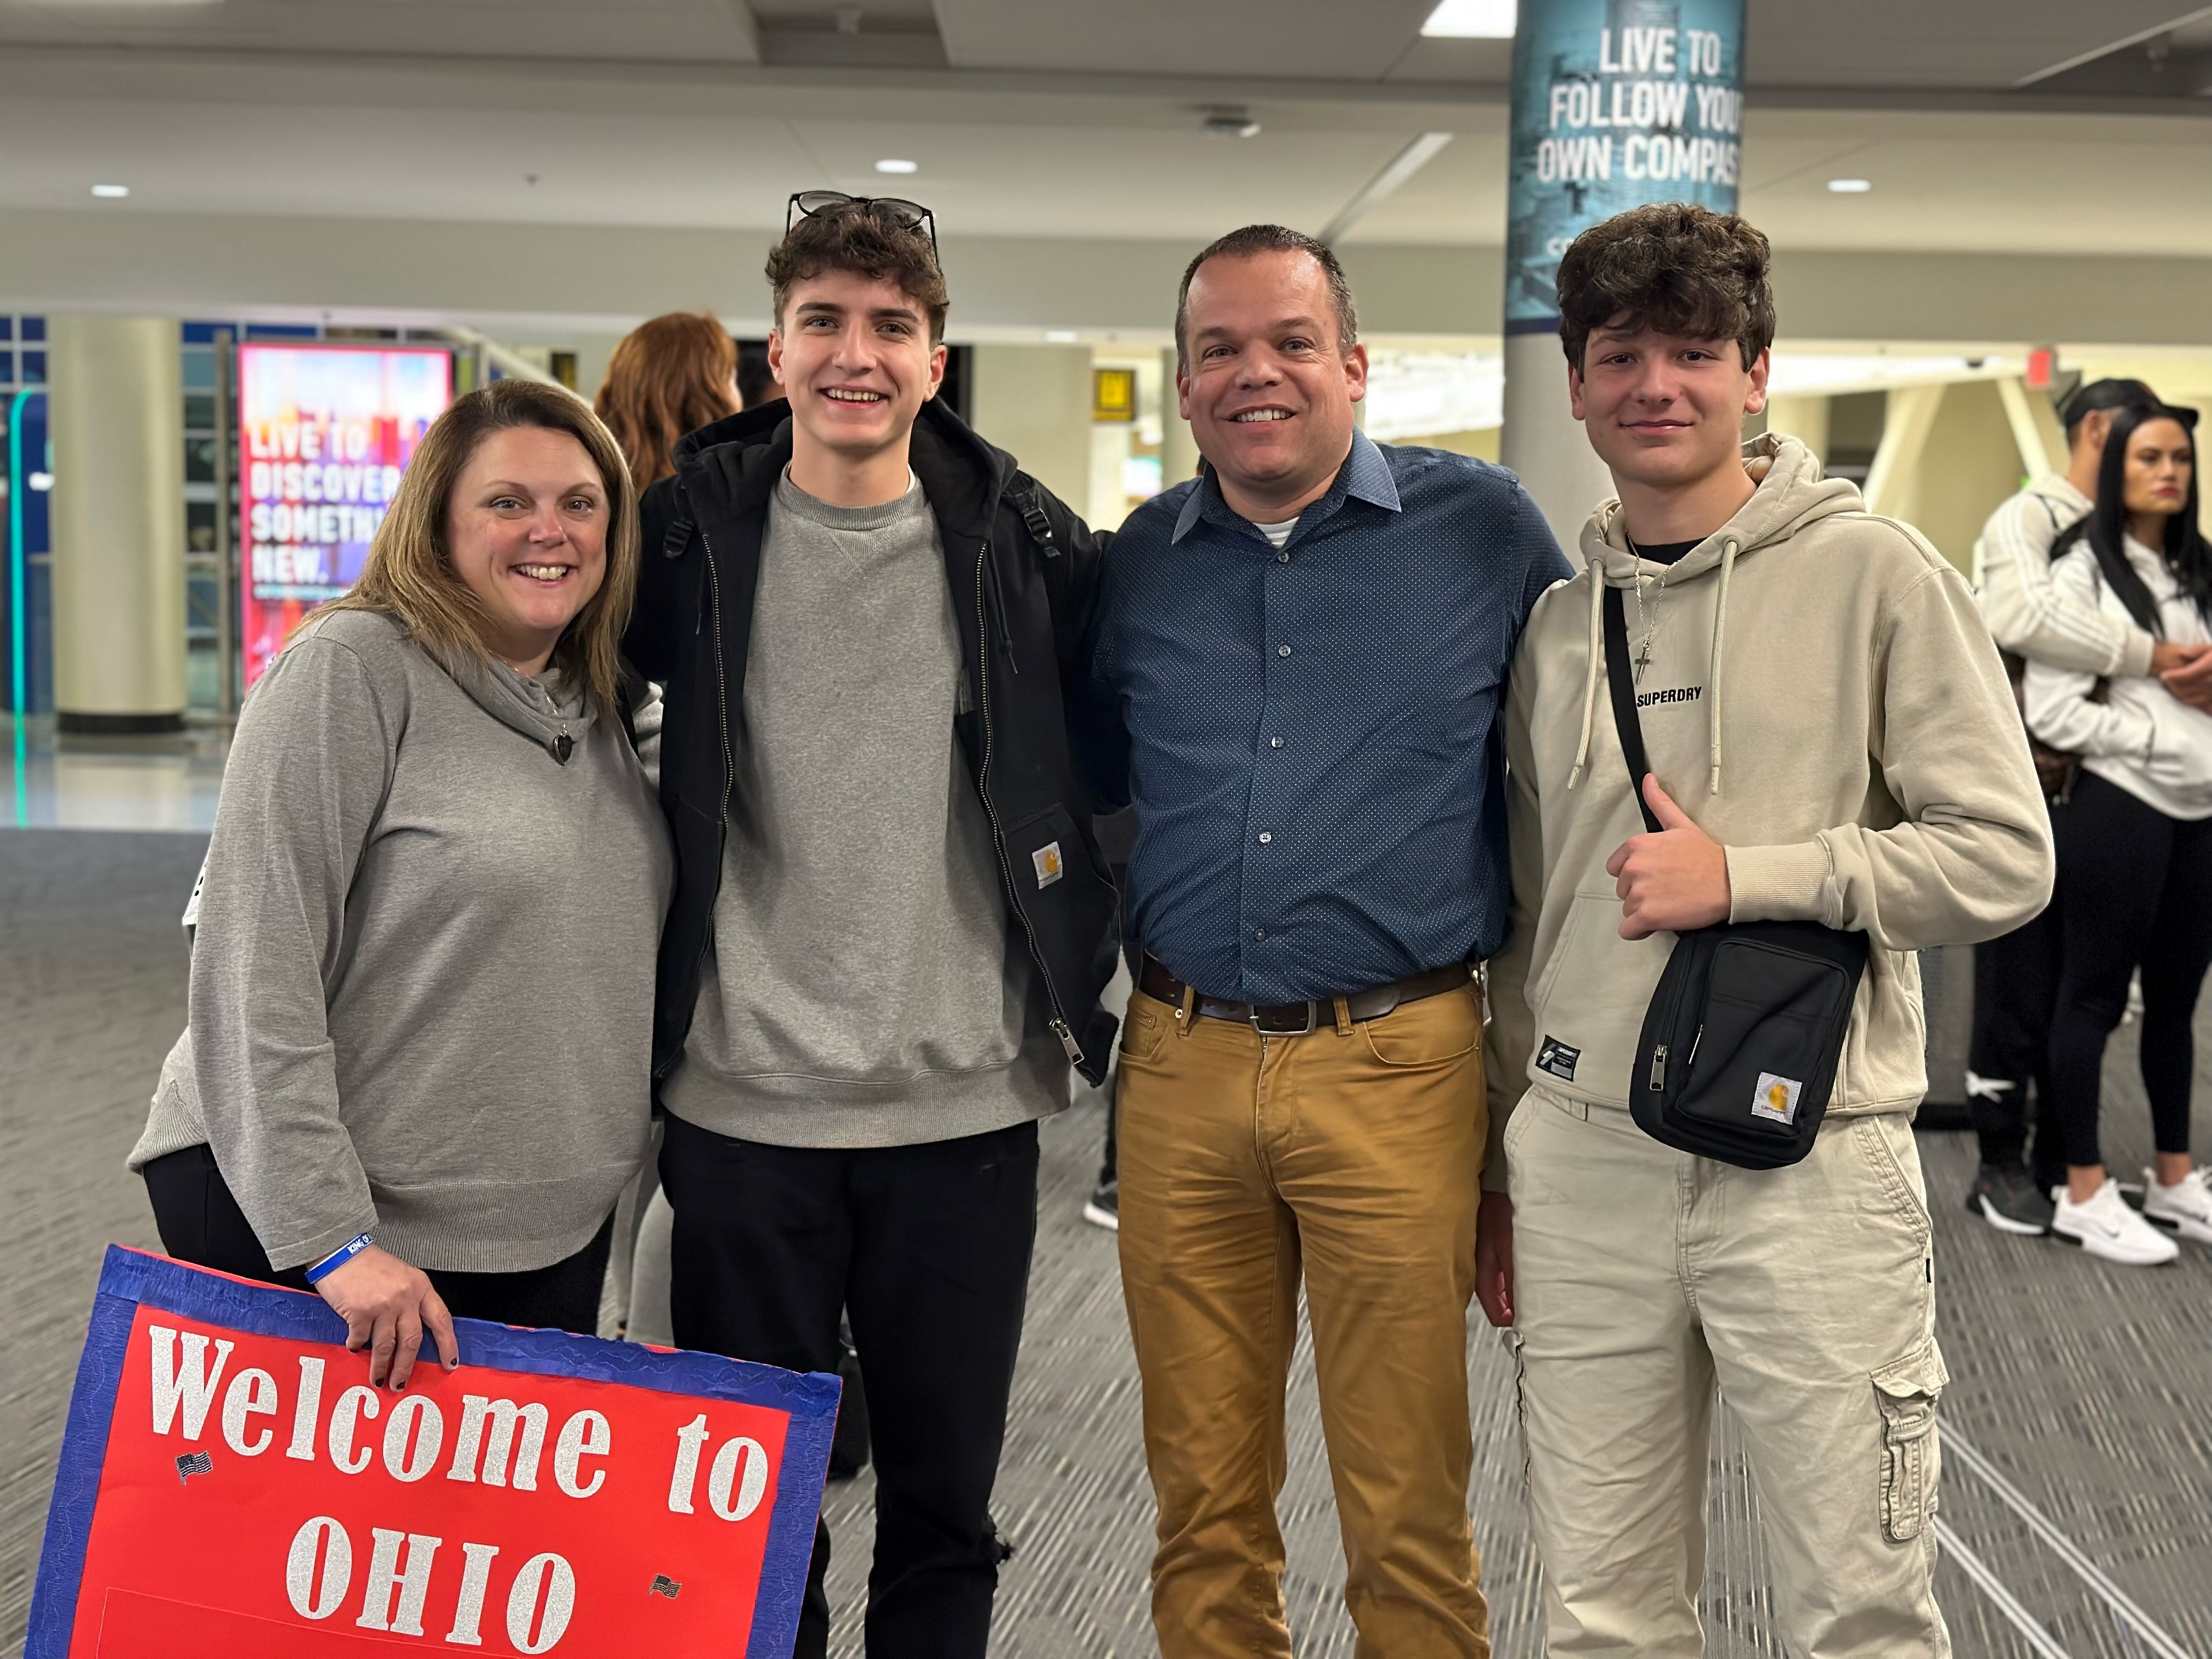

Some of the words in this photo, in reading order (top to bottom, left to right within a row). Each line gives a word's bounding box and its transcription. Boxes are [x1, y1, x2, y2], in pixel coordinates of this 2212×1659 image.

[1599, 28, 1675, 74] LIVE
[1687, 30, 1721, 77] TO
[1549, 83, 1689, 129] FOLLOW
[1538, 136, 1611, 183] OWN
[250, 422, 321, 459] LIVE
[333, 422, 367, 460] TO
[250, 462, 401, 501] DISCOVER
[252, 545, 329, 584] NEW.
[1637, 687, 1702, 707] SUPERDRY
[348, 1239, 364, 1254] KING
[149, 1325, 611, 1498] Welcome
[668, 1414, 768, 1521] to
[285, 1515, 576, 1655] OHIO
